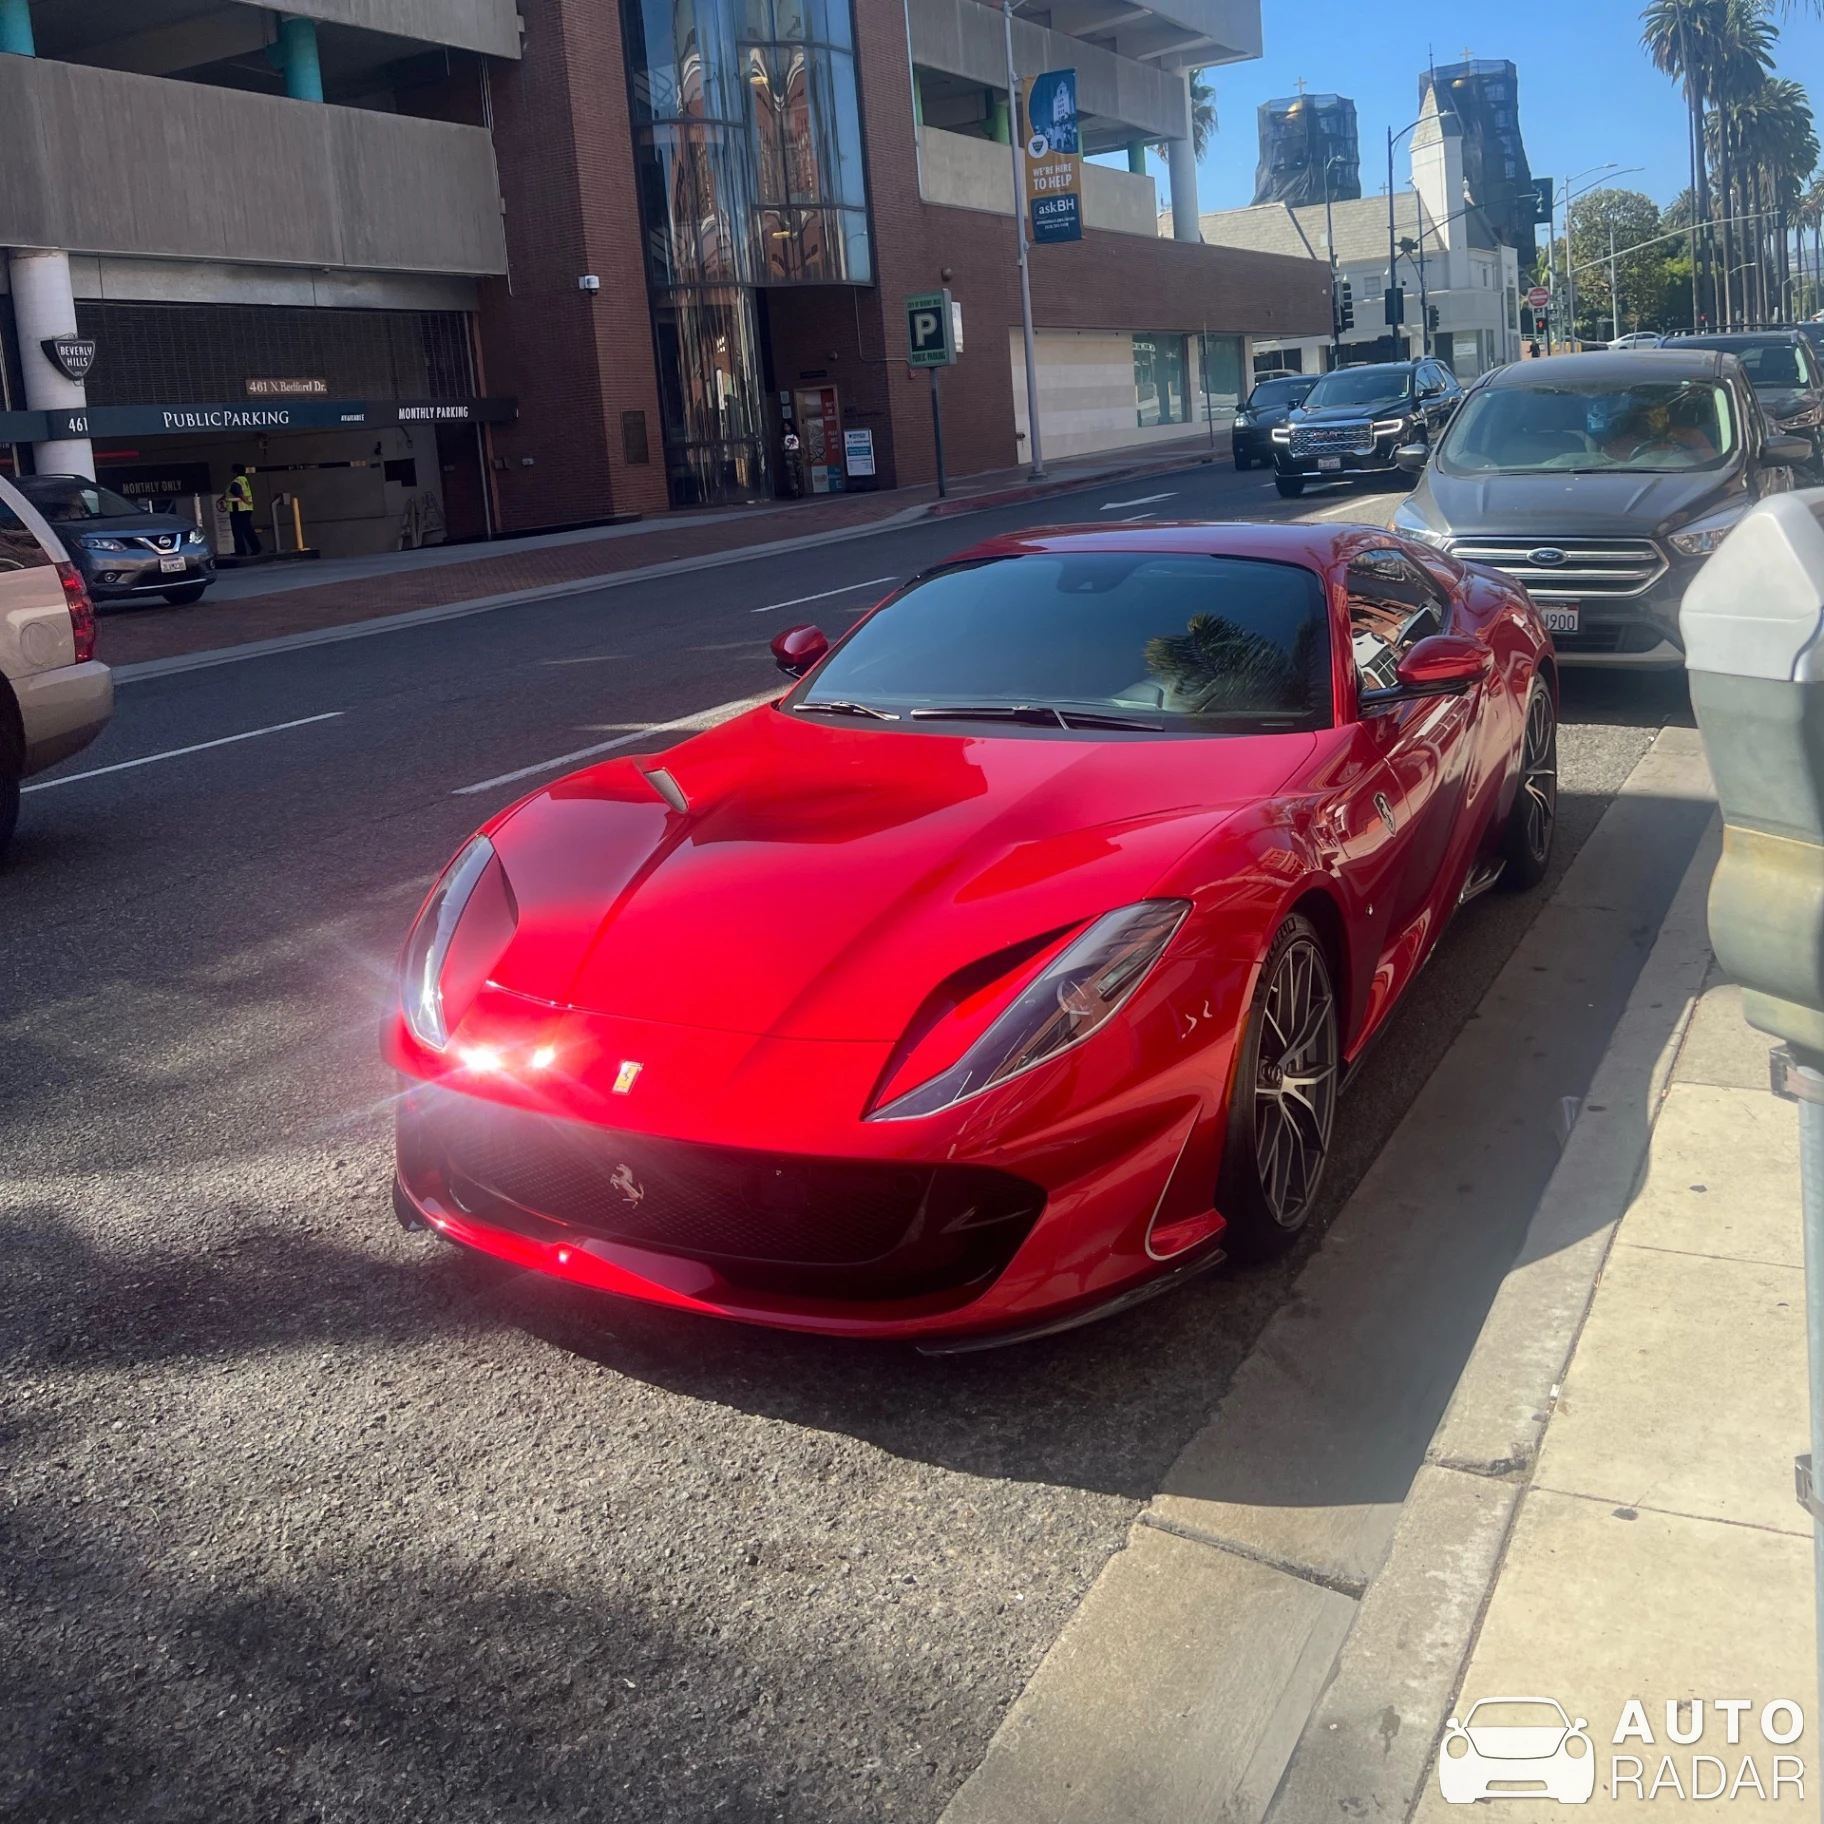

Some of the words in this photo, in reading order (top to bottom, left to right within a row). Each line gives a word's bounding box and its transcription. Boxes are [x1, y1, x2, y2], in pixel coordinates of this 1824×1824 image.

[1033, 166, 1054, 176] WE'RE
[1055, 163, 1072, 173] HERE
[1034, 178, 1047, 190] TO
[1049, 174, 1072, 189] HELP
[1039, 198, 1075, 214] askBH
[914, 312, 938, 347] P
[60, 346, 92, 356] BEVERLY
[67, 357, 88, 367] HILLS
[249, 381, 268, 392] 461
[270, 382, 279, 392] N
[280, 381, 312, 392] Bedford
[313, 380, 327, 392] Dr.
[163, 411, 222, 428] PUBLIC
[223, 410, 289, 427] PARKING
[398, 407, 435, 420] MONTHLY
[436, 406, 468, 419] PARKING
[68, 417, 88, 432] 461
[122, 481, 159, 495] MONTHLY
[162, 480, 182, 492] ONLY
